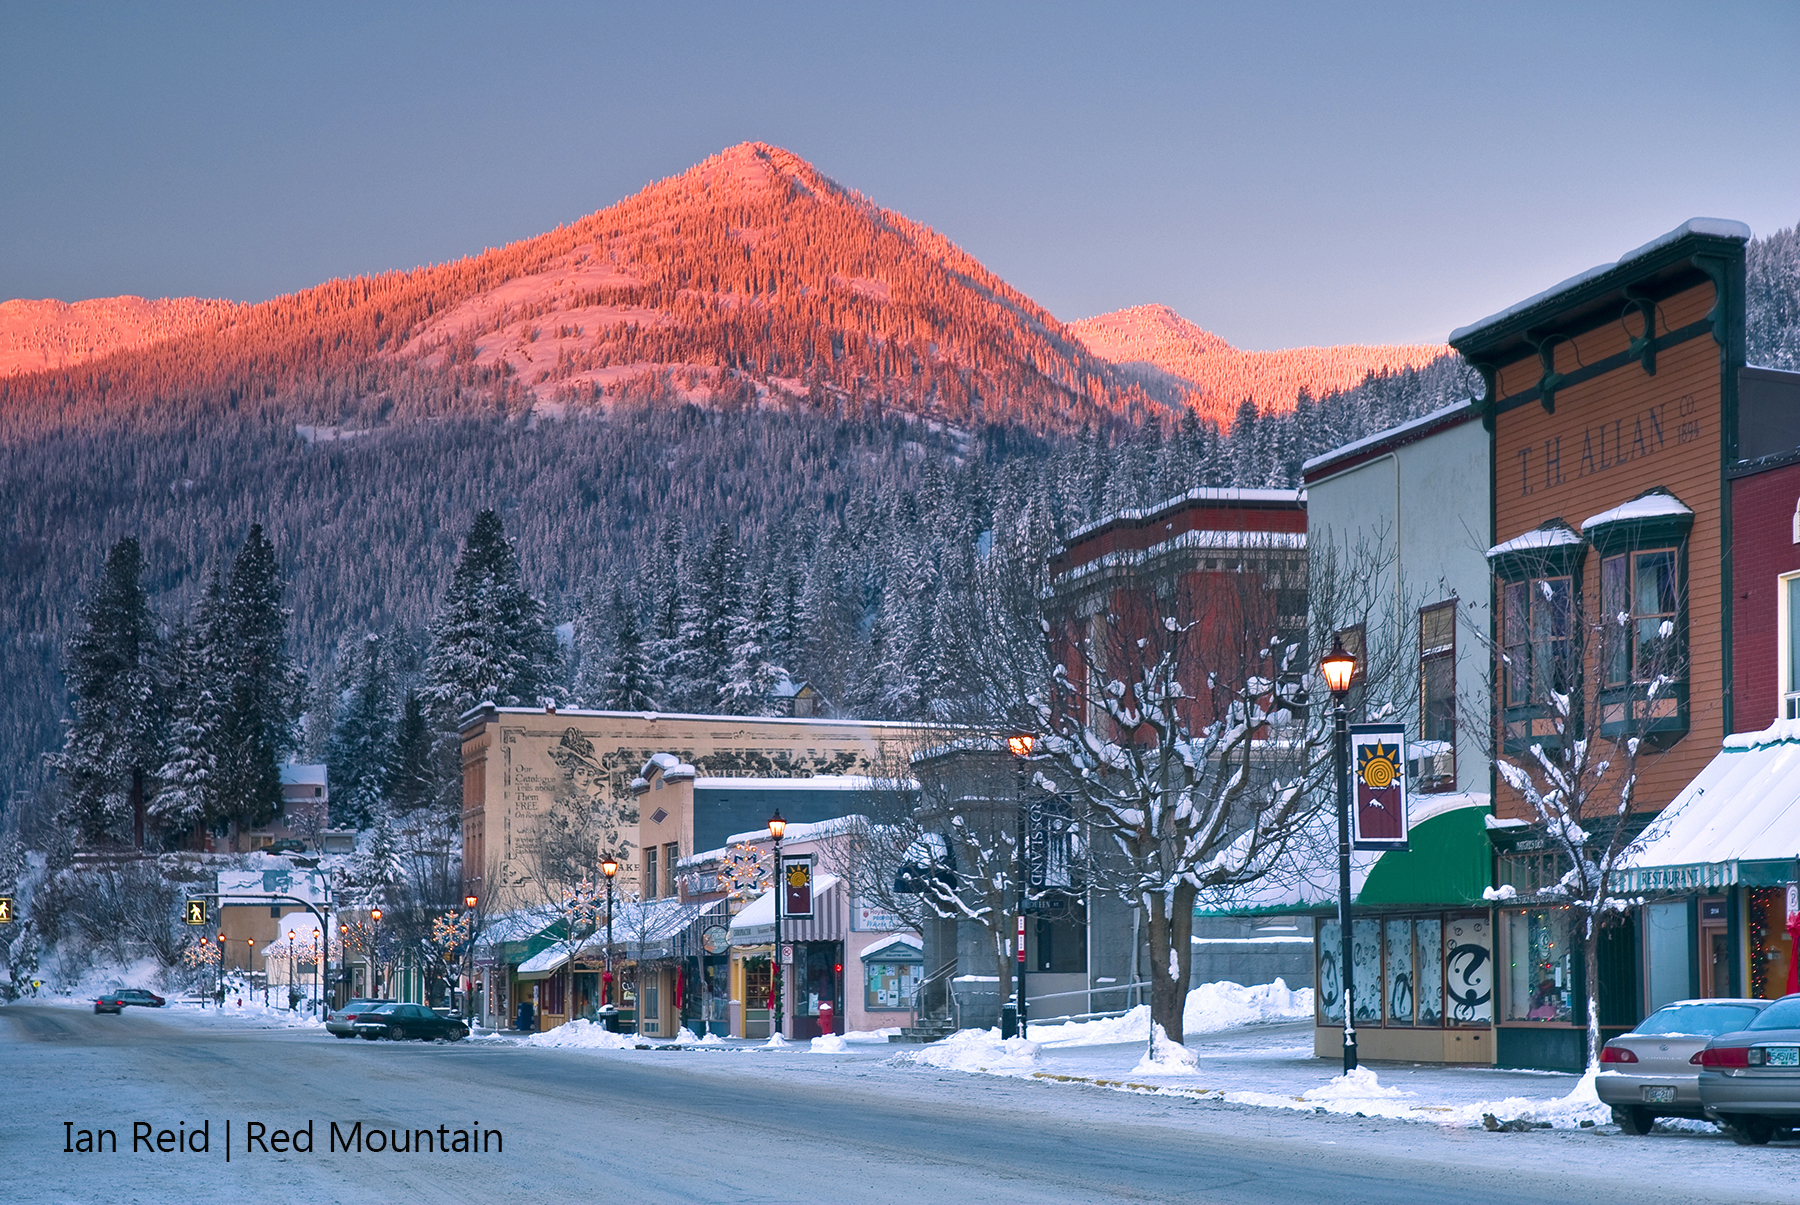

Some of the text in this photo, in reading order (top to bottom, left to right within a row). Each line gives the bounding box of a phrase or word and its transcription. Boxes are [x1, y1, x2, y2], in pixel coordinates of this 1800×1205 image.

[1679, 395, 1697, 418] CO.
[1677, 419, 1700, 444] 1894
[1517, 404, 1665, 496] T. H. ALLAN
[515, 764, 533, 773] Our
[515, 774, 556, 785] Catalogue
[535, 782, 555, 791] about
[515, 792, 539, 801] Them
[515, 802, 538, 810] FREE
[1030, 801, 1043, 886] ROSSLAND
[1641, 869, 1699, 884] RESTAURANT
